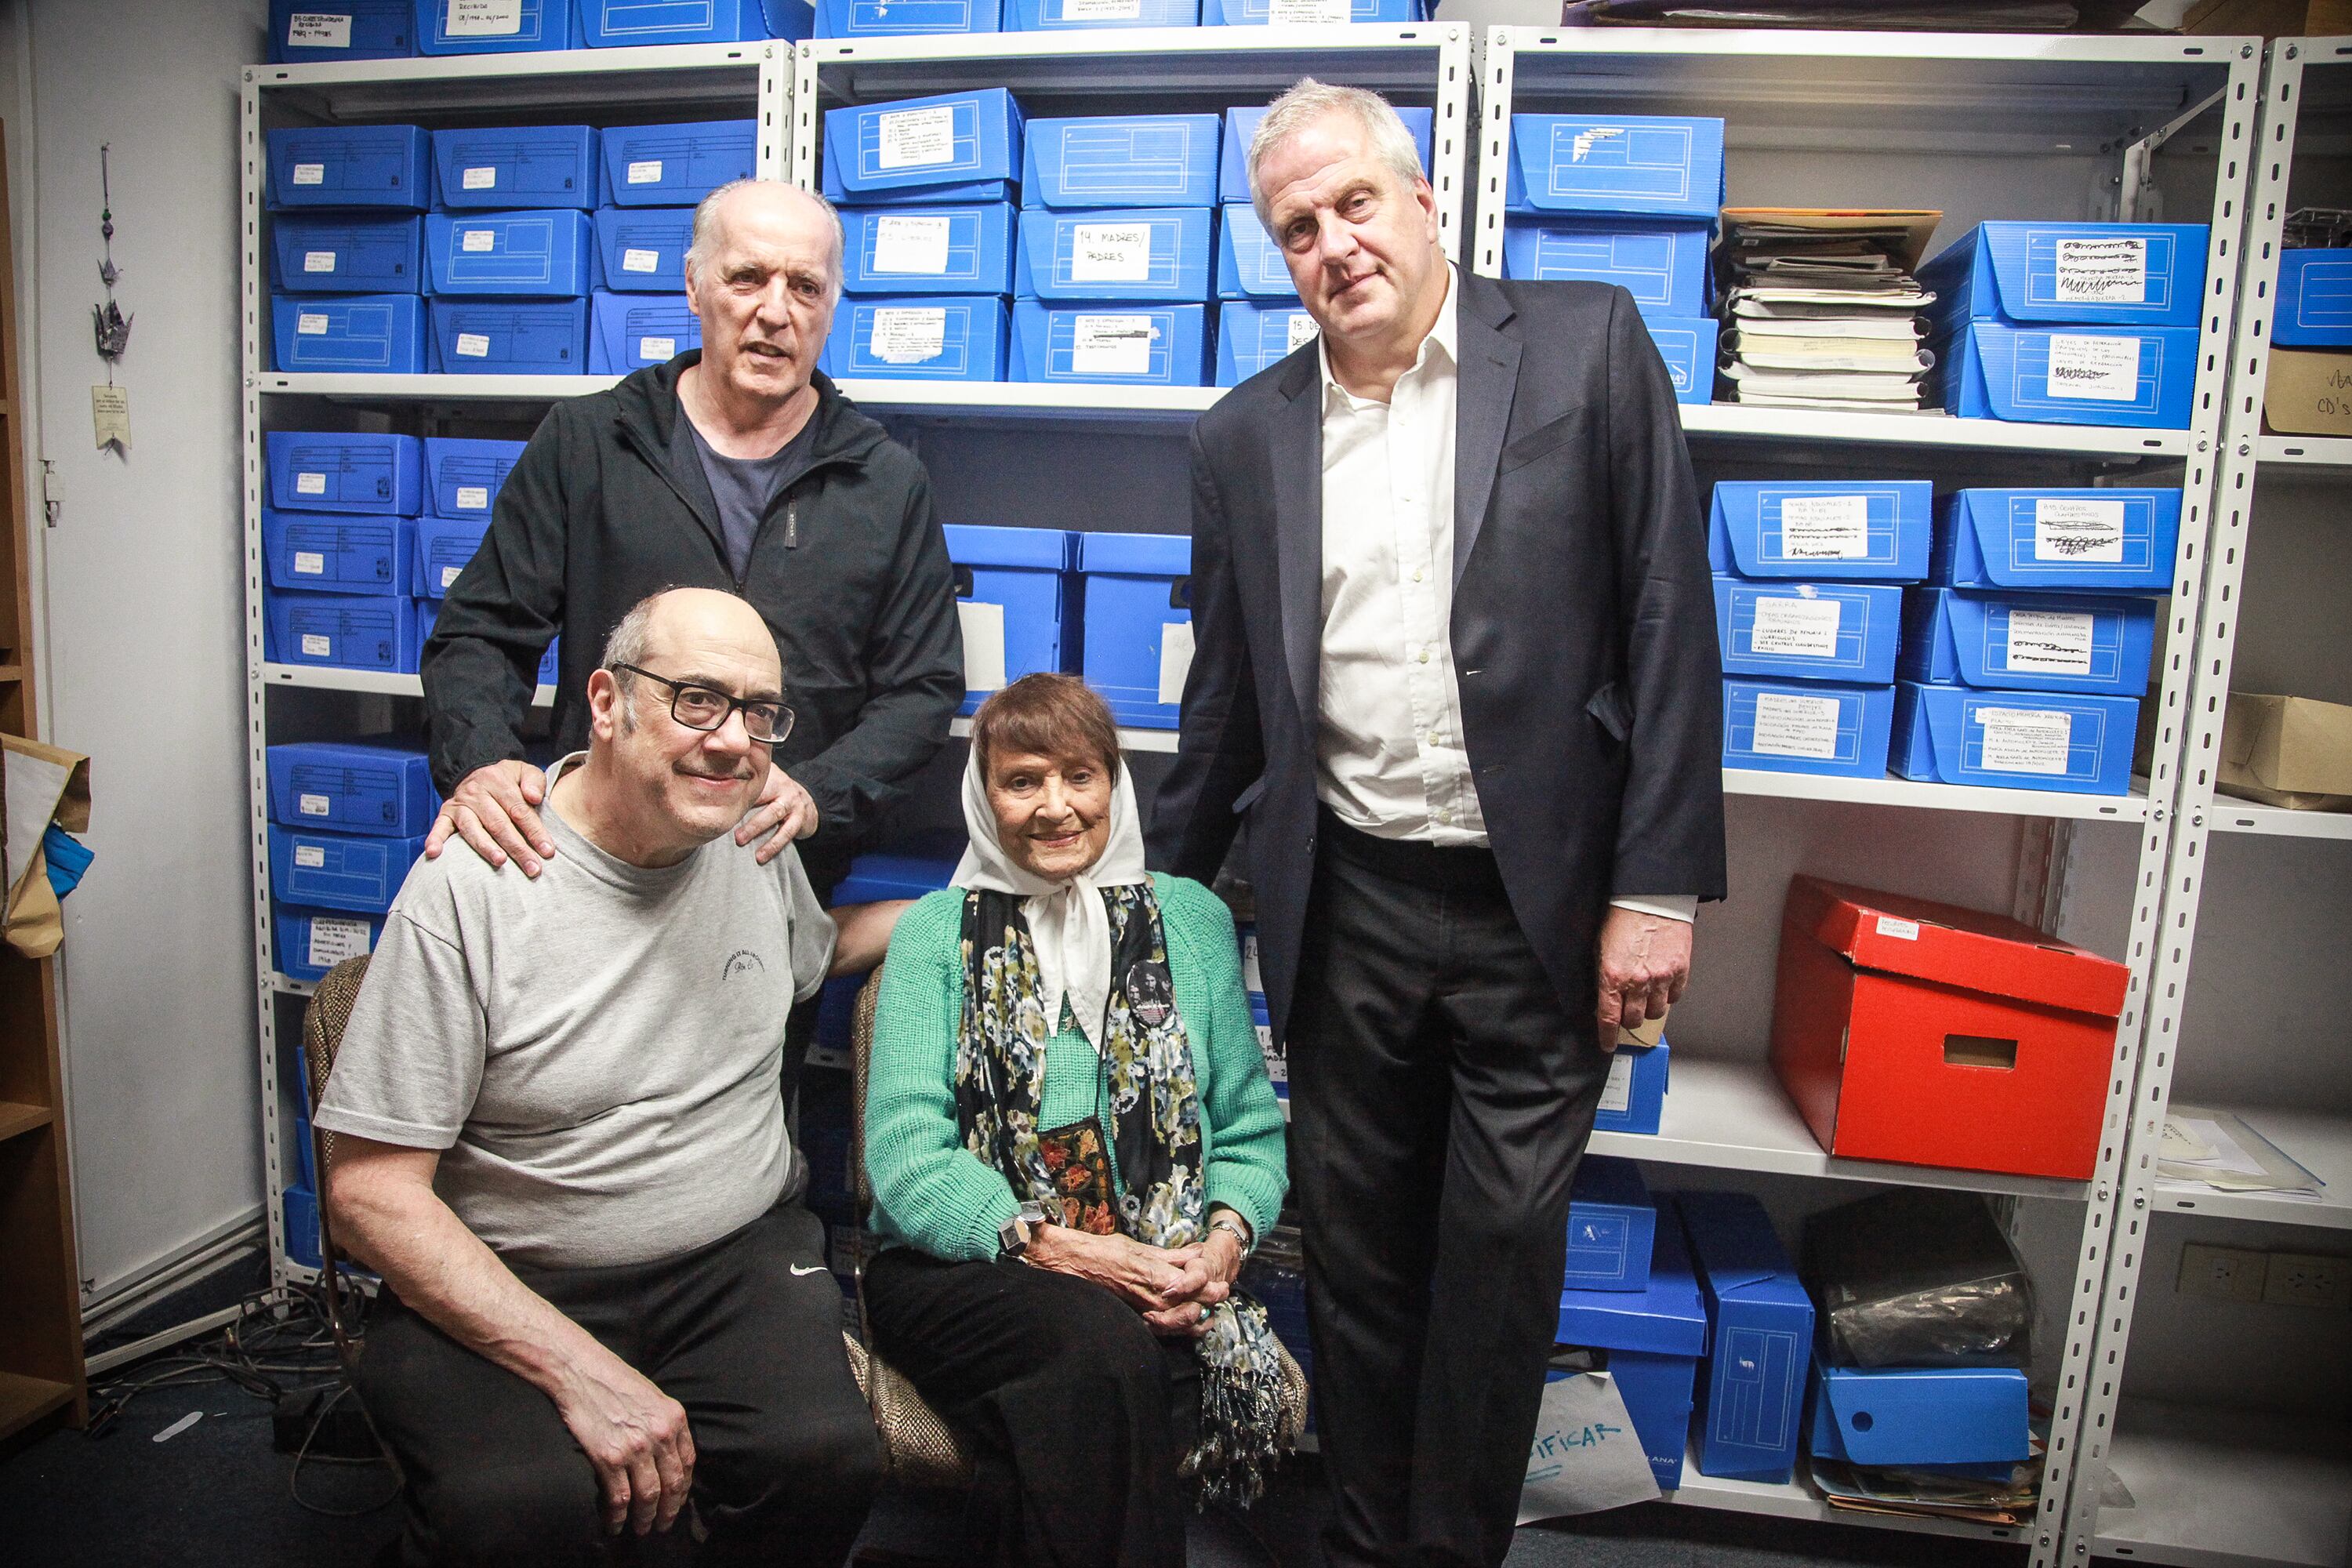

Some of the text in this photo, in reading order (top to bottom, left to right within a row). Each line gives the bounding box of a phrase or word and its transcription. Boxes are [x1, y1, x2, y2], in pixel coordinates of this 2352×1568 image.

[1087, 251, 1124, 262] PADRES
[2318, 397, 2350, 416] CD's
[722, 953, 737, 981] TURNING
